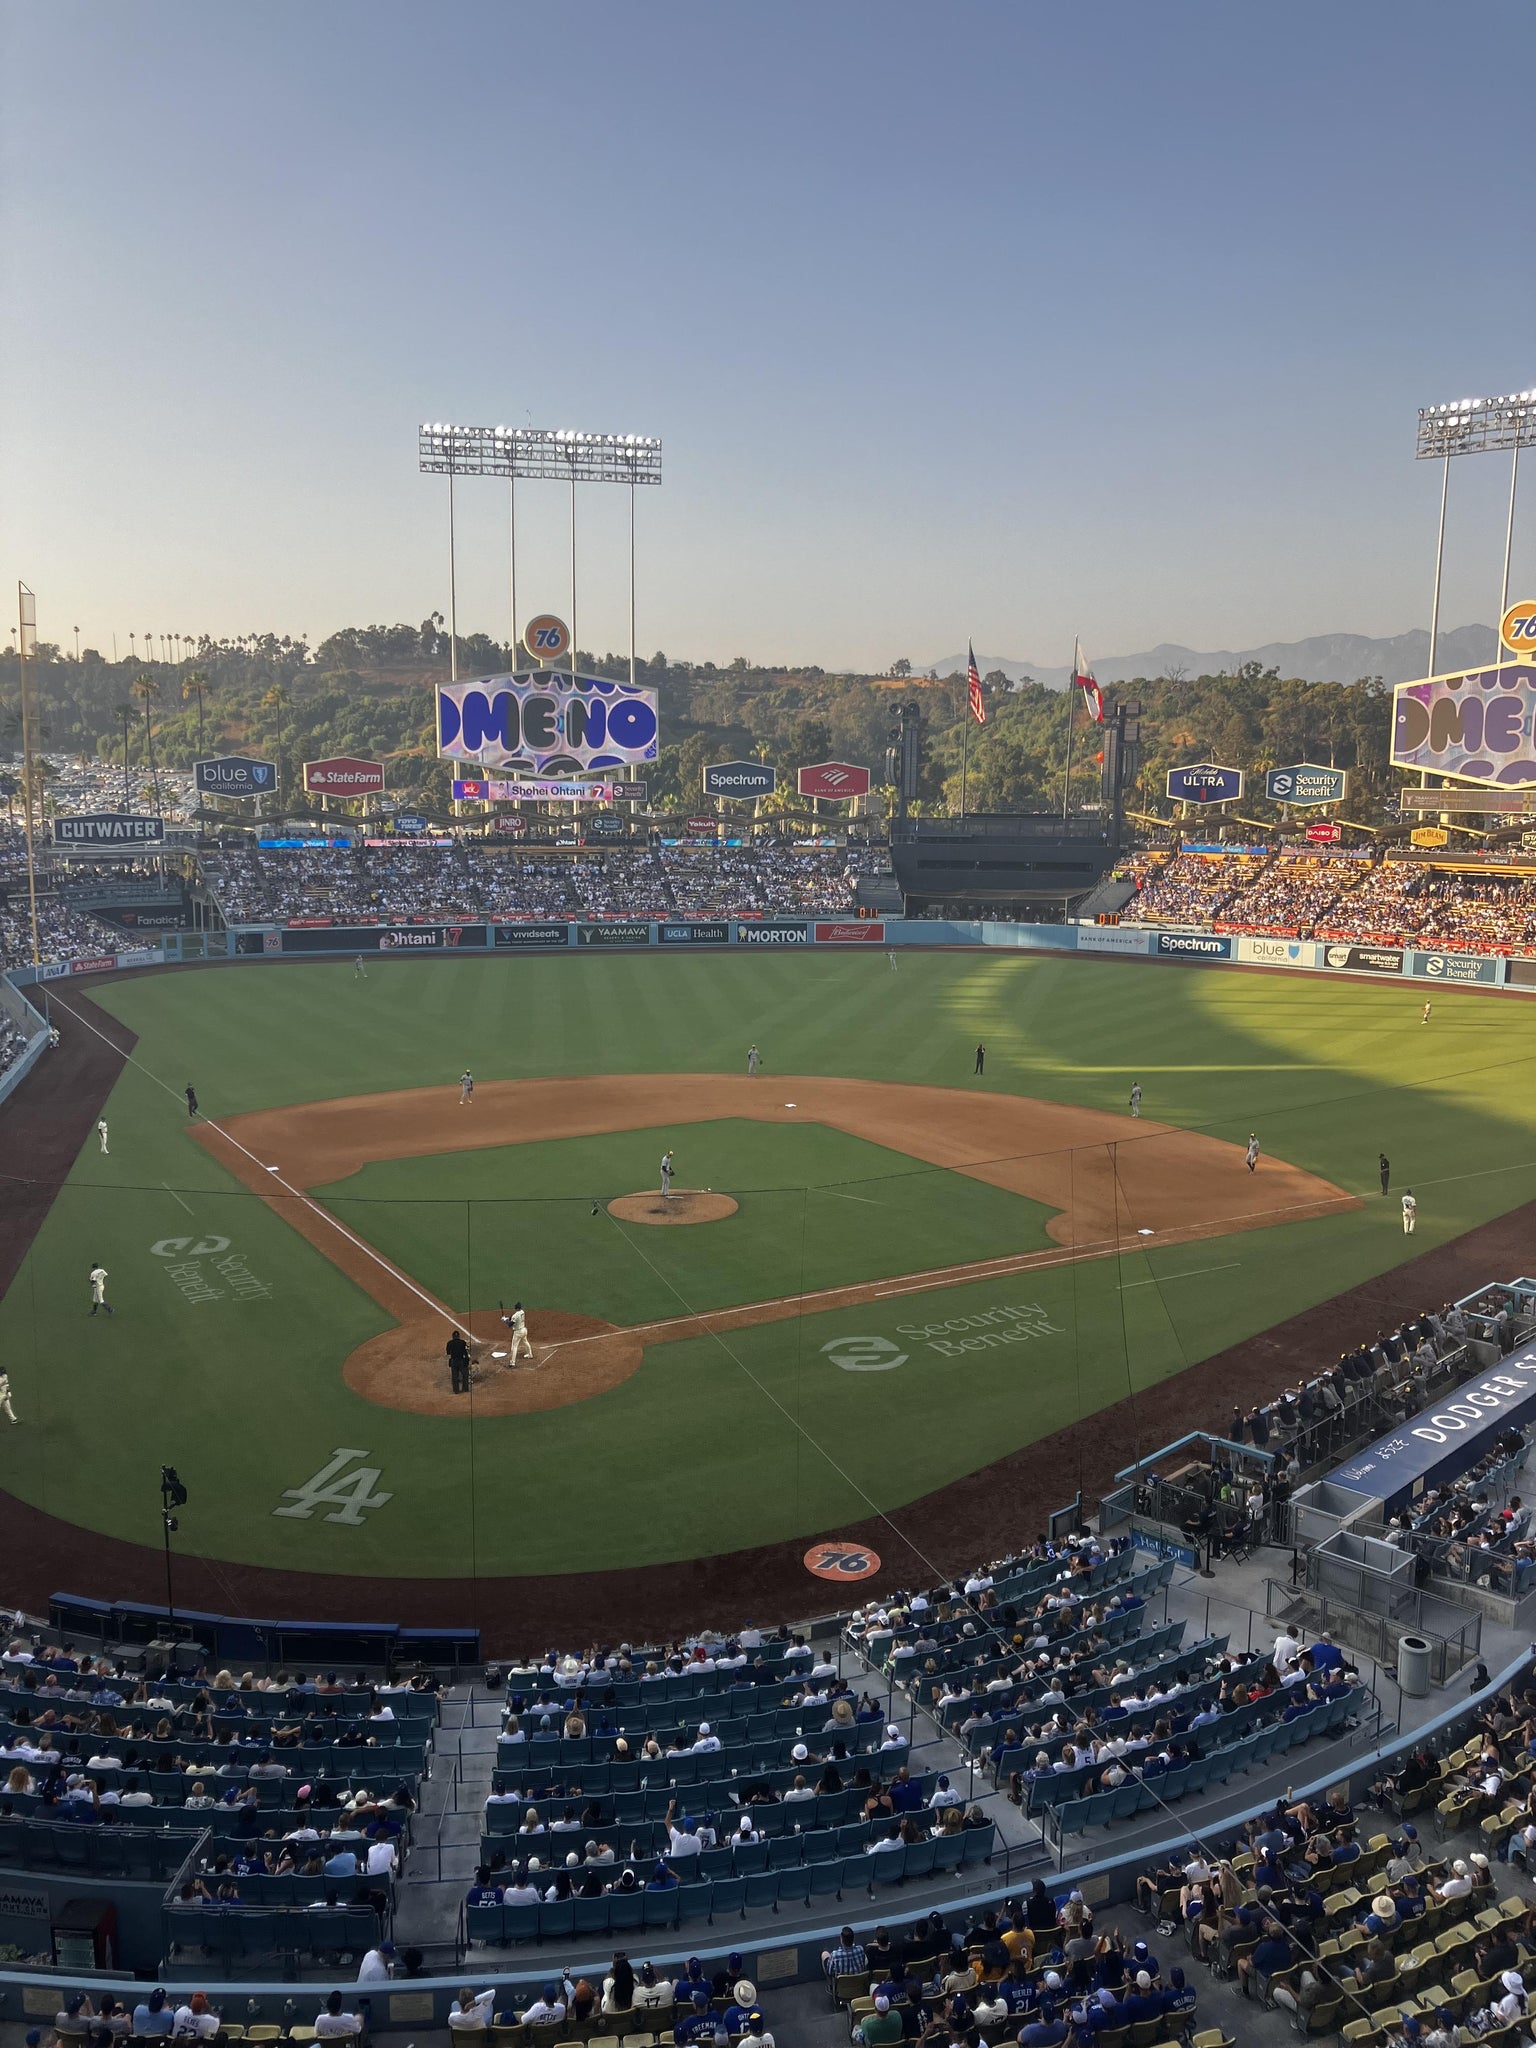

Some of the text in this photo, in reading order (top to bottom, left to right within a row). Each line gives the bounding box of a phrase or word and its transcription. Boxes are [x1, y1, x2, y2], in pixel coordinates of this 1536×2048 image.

[536, 628, 561, 648] 76
[203, 764, 247, 782] blue
[211, 782, 253, 790] california
[710, 773, 766, 787] Spectrum
[1183, 776, 1225, 787] ULTRA
[1296, 774, 1338, 788] Security
[512, 785, 549, 796] Shohei
[551, 785, 585, 796] Ohtani
[1296, 786, 1334, 796] Benefit
[500, 818, 521, 827] JINRO
[62, 822, 156, 838] CUTWATER
[1413, 830, 1444, 842] JIM BEAM
[137, 915, 179, 925] Fanatics
[513, 929, 560, 938] vividseats
[598, 927, 648, 935] YAAMAVA'
[668, 929, 723, 938] UCLA Health
[748, 930, 807, 942] MORTON
[834, 929, 868, 938] Budweiser
[267, 937, 279, 947] 76
[1161, 936, 1222, 952] Spectrum
[1253, 941, 1285, 956] blue
[1257, 955, 1288, 963] california
[1329, 952, 1347, 960] smart
[1359, 952, 1401, 963] smartwater
[1447, 958, 1482, 972] Security
[45, 966, 61, 977] ANA
[1446, 968, 1477, 980] Benefit
[164, 1261, 224, 1304] Benefit
[896, 1302, 1048, 1341] Security
[923, 1319, 1066, 1357] Benefit
[1411, 1375, 1528, 1443] DODGER
[271, 1447, 395, 1526] LA
[812, 1550, 873, 1573] 76
[482, 1891, 496, 1899] BETTS
